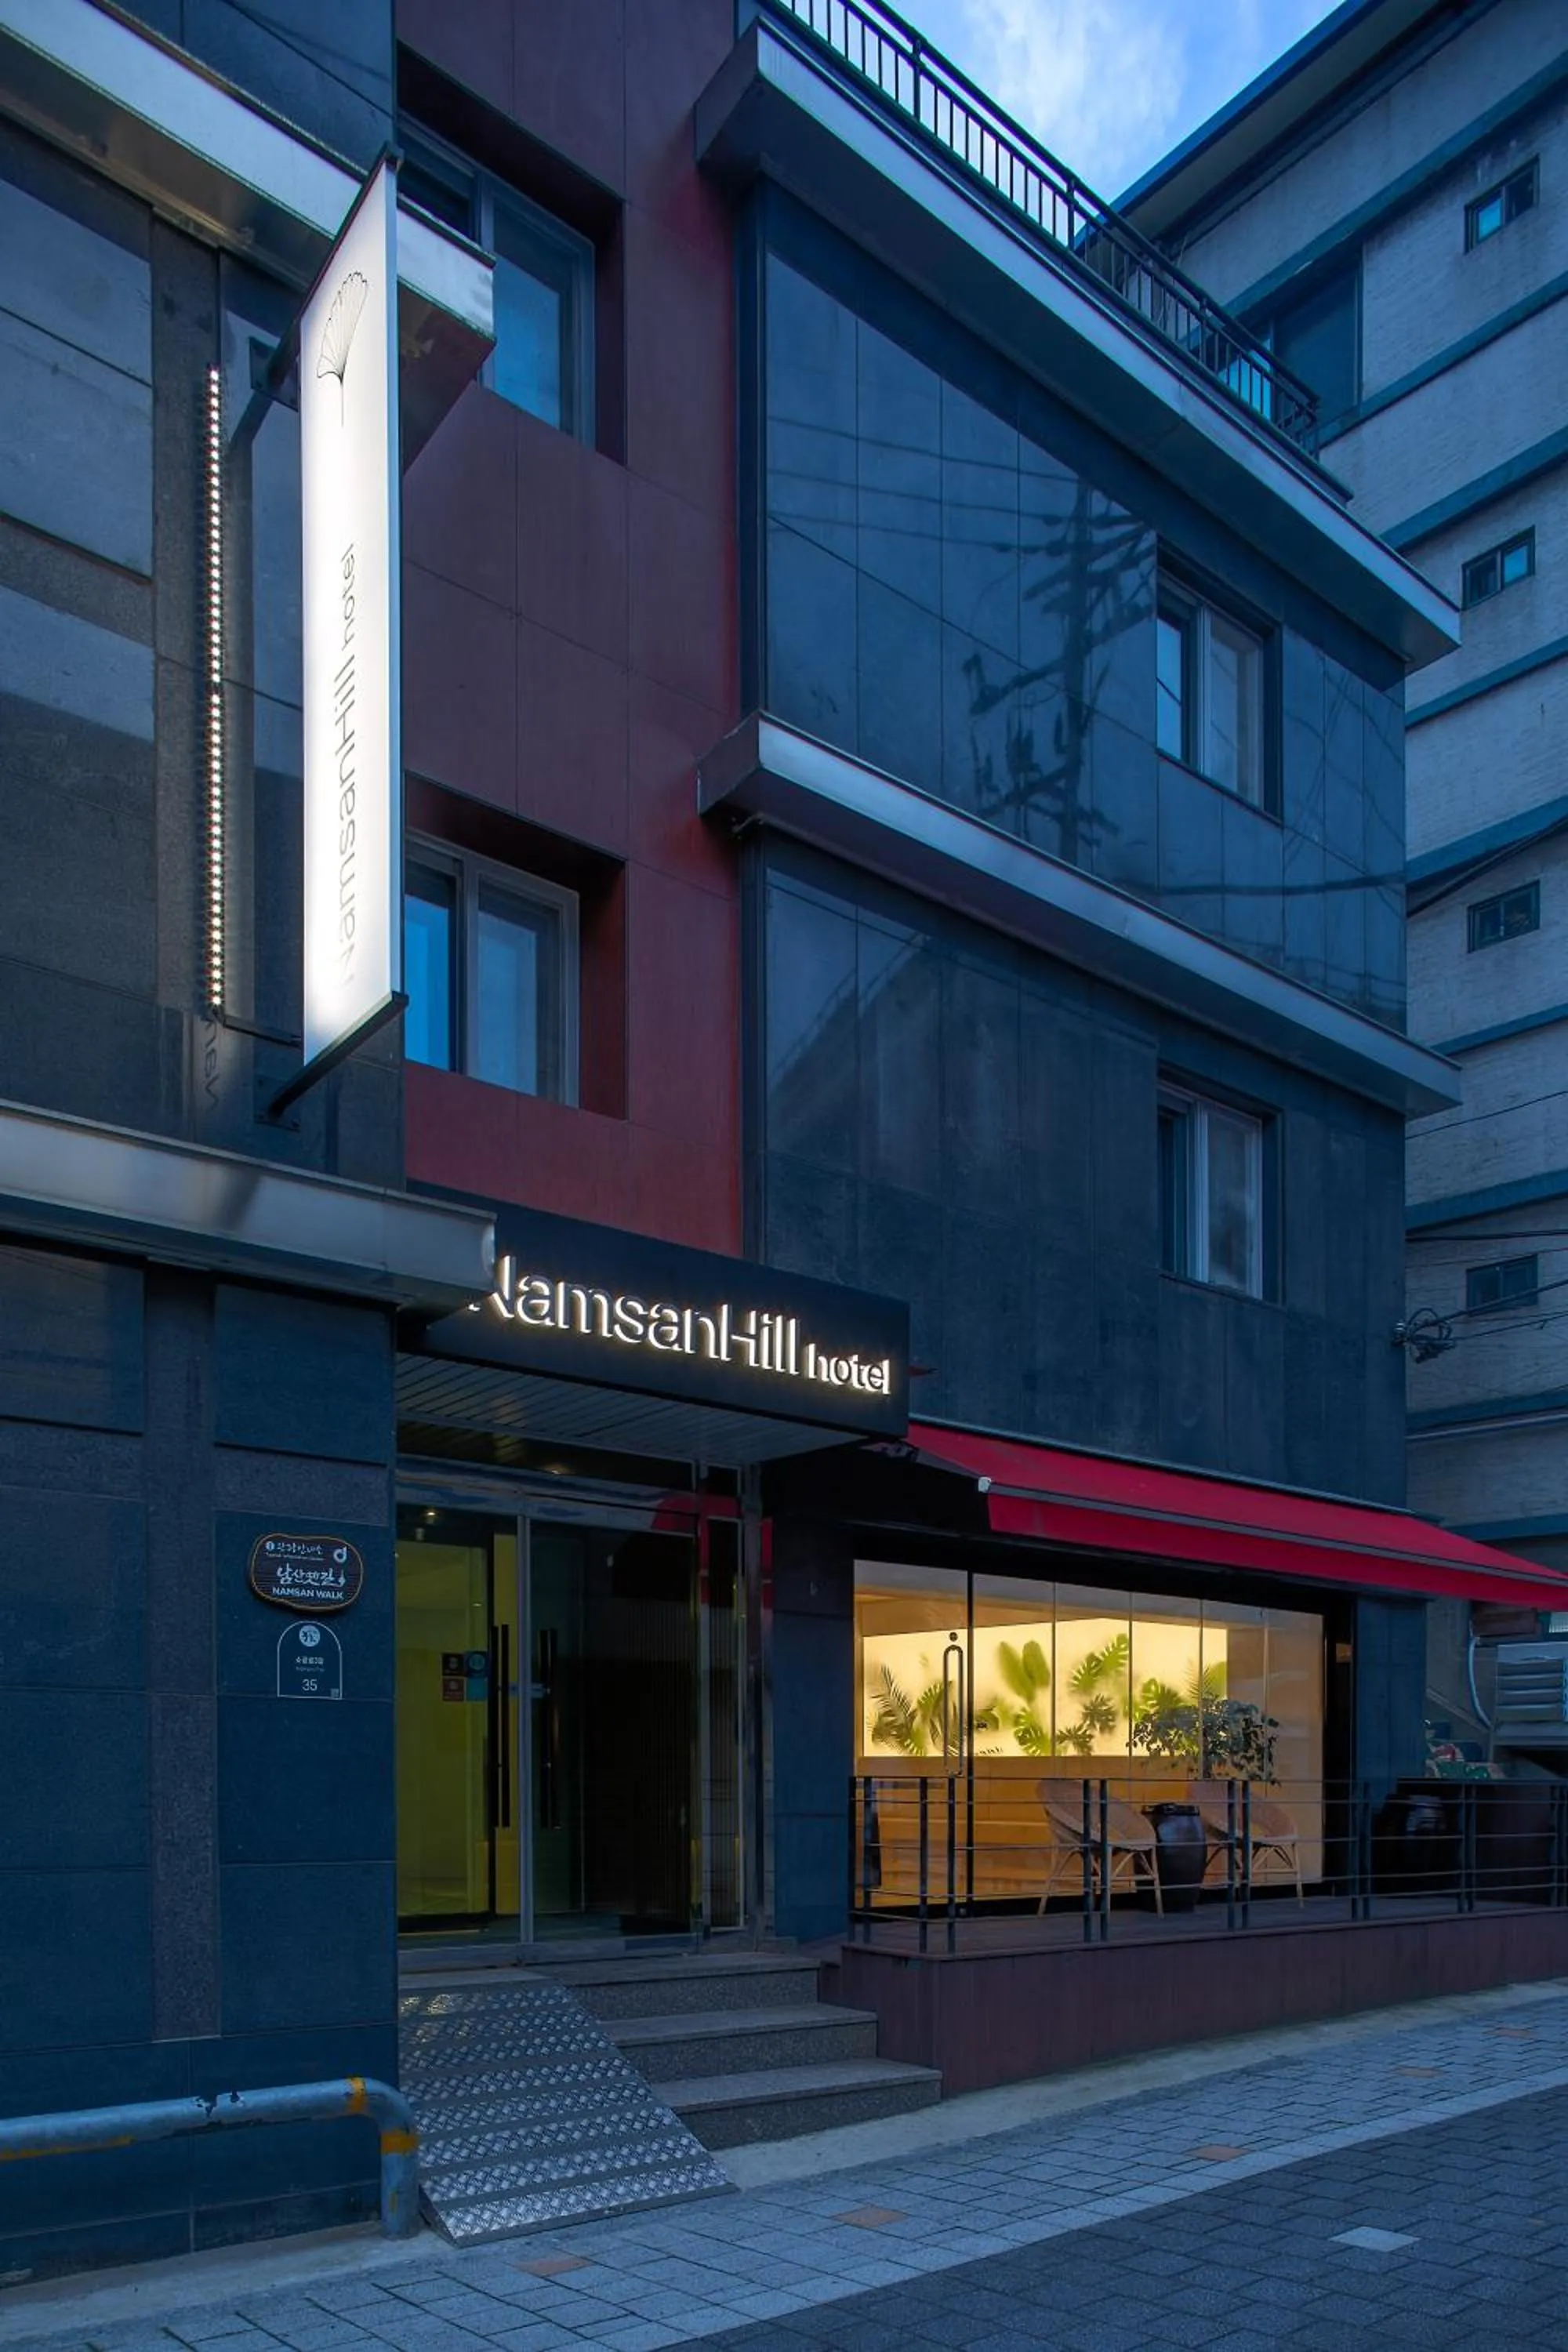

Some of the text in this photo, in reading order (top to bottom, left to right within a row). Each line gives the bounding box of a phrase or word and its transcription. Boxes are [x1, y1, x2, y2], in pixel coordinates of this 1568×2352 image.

[339, 543, 356, 652] hotel
[807, 1342, 891, 1396] hotel
[272, 1586, 344, 1600] NAMSAN WALK
[302, 1679, 318, 1691] 35
